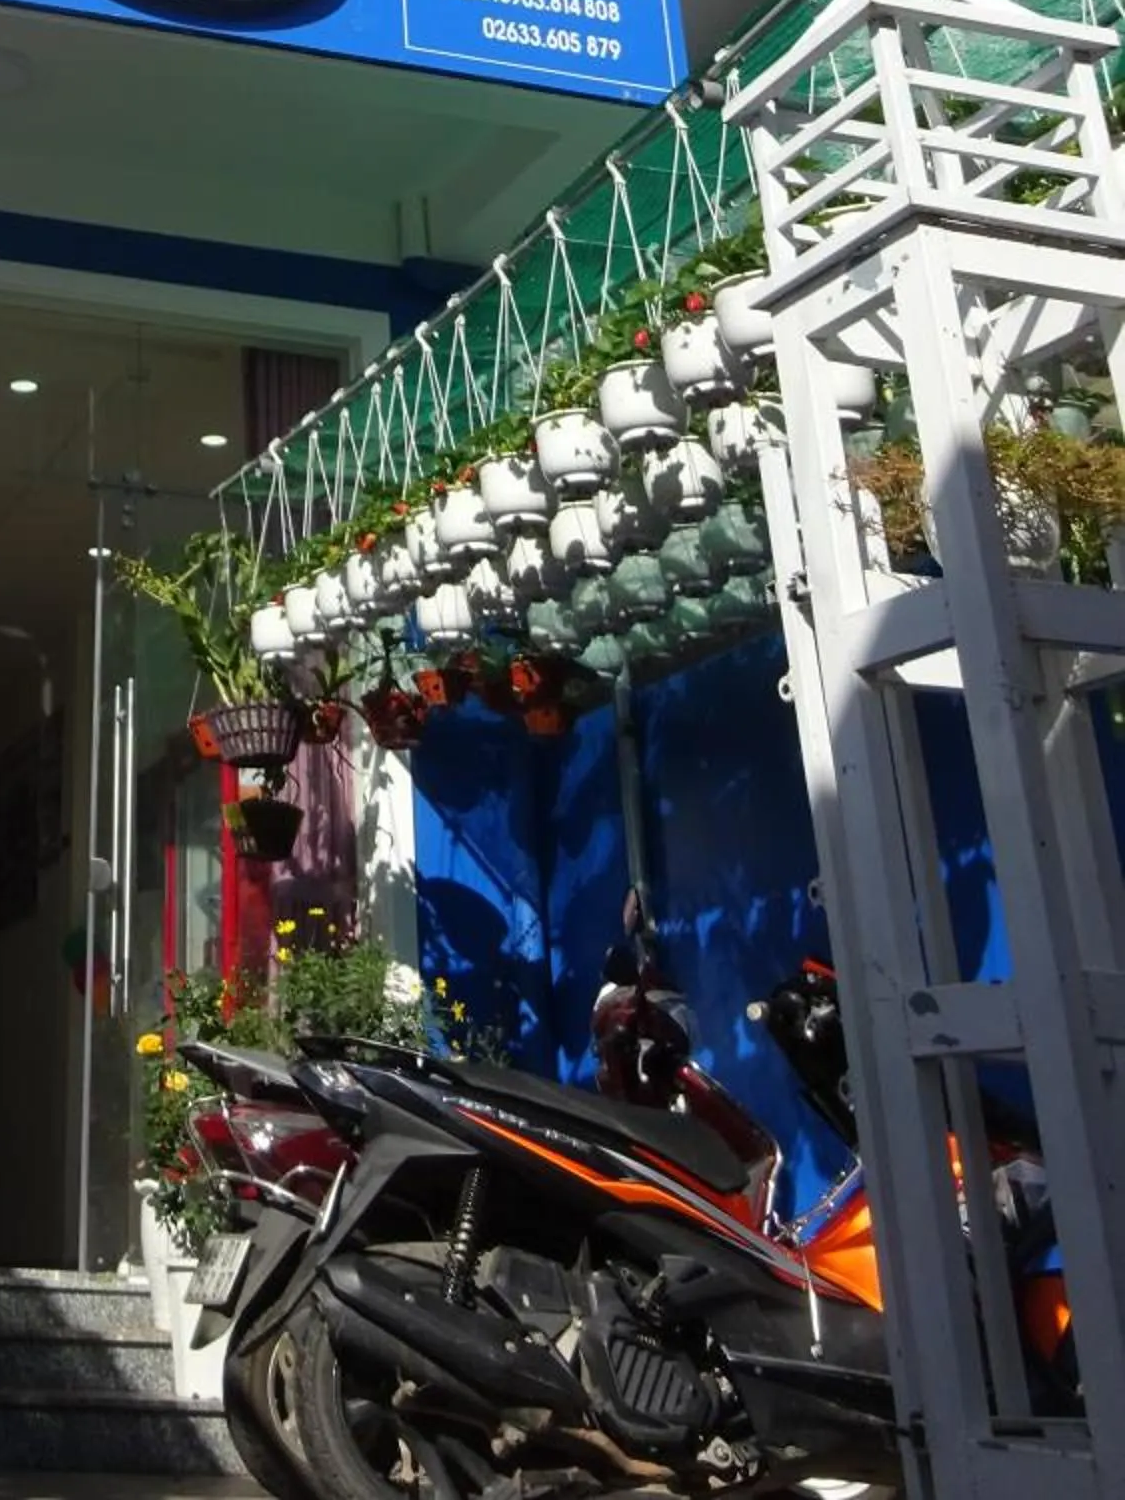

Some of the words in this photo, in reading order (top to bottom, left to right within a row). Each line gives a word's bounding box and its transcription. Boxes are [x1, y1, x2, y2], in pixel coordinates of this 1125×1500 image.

[583, 0, 621, 23] 808
[481, 17, 582, 53] 02633.605
[585, 34, 622, 61] 879
